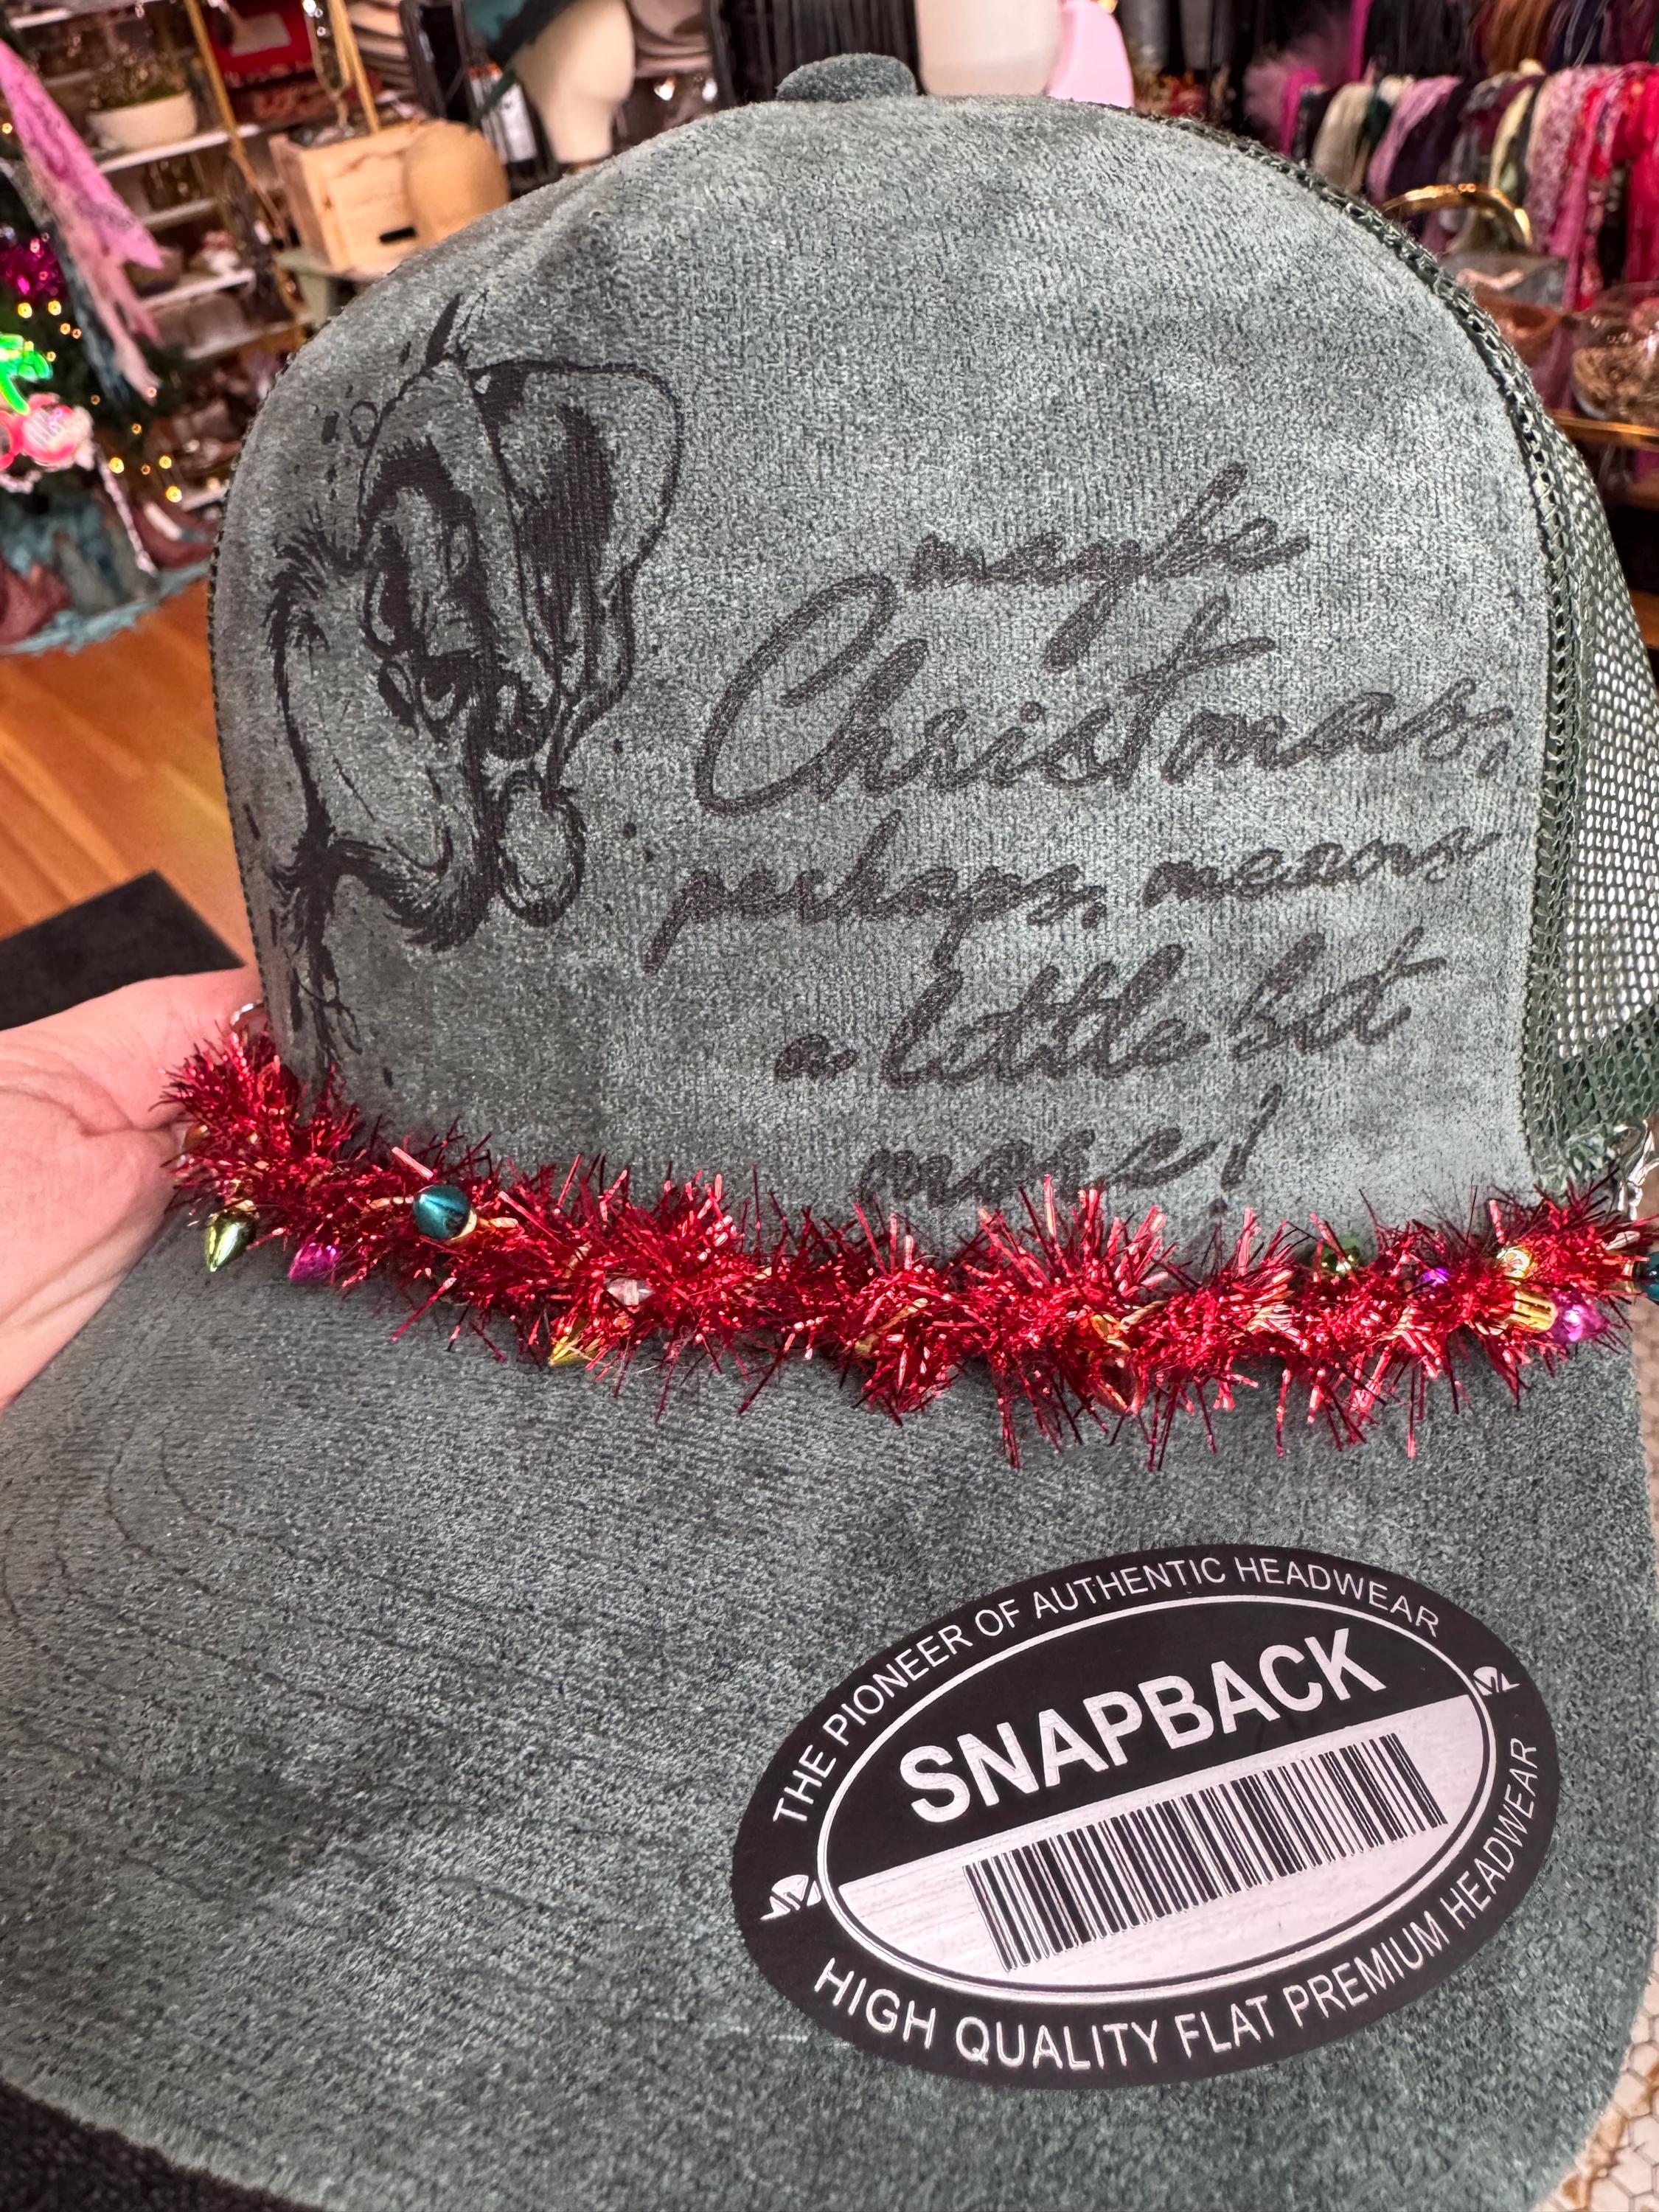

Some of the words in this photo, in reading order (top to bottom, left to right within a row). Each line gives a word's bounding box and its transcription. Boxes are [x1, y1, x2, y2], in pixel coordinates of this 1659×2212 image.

[907, 462, 1310, 672] maybe
[1142, 825, 1500, 908] means
[773, 1032, 859, 1082] a
[888, 943, 1211, 1089] little
[1230, 925, 1447, 1063] bit
[859, 1084, 1284, 1218] more!
[772, 1744, 837, 1823] THE
[828, 1624, 973, 1747] PIONEER
[975, 1599, 1023, 1637] OF
[1032, 1557, 1227, 1620] AUTHENTIC
[1236, 1557, 1440, 1638] HEADWEAR
[899, 1627, 1387, 1823] SNAPBACK
[813, 1957, 937, 2050] HIGH
[956, 2015, 1159, 2070] QUALITY
[1174, 1994, 1276, 2059] FLAT
[1282, 1910, 1452, 2029] PREMIUM
[1439, 1736, 1540, 1931] HEADWEAR
